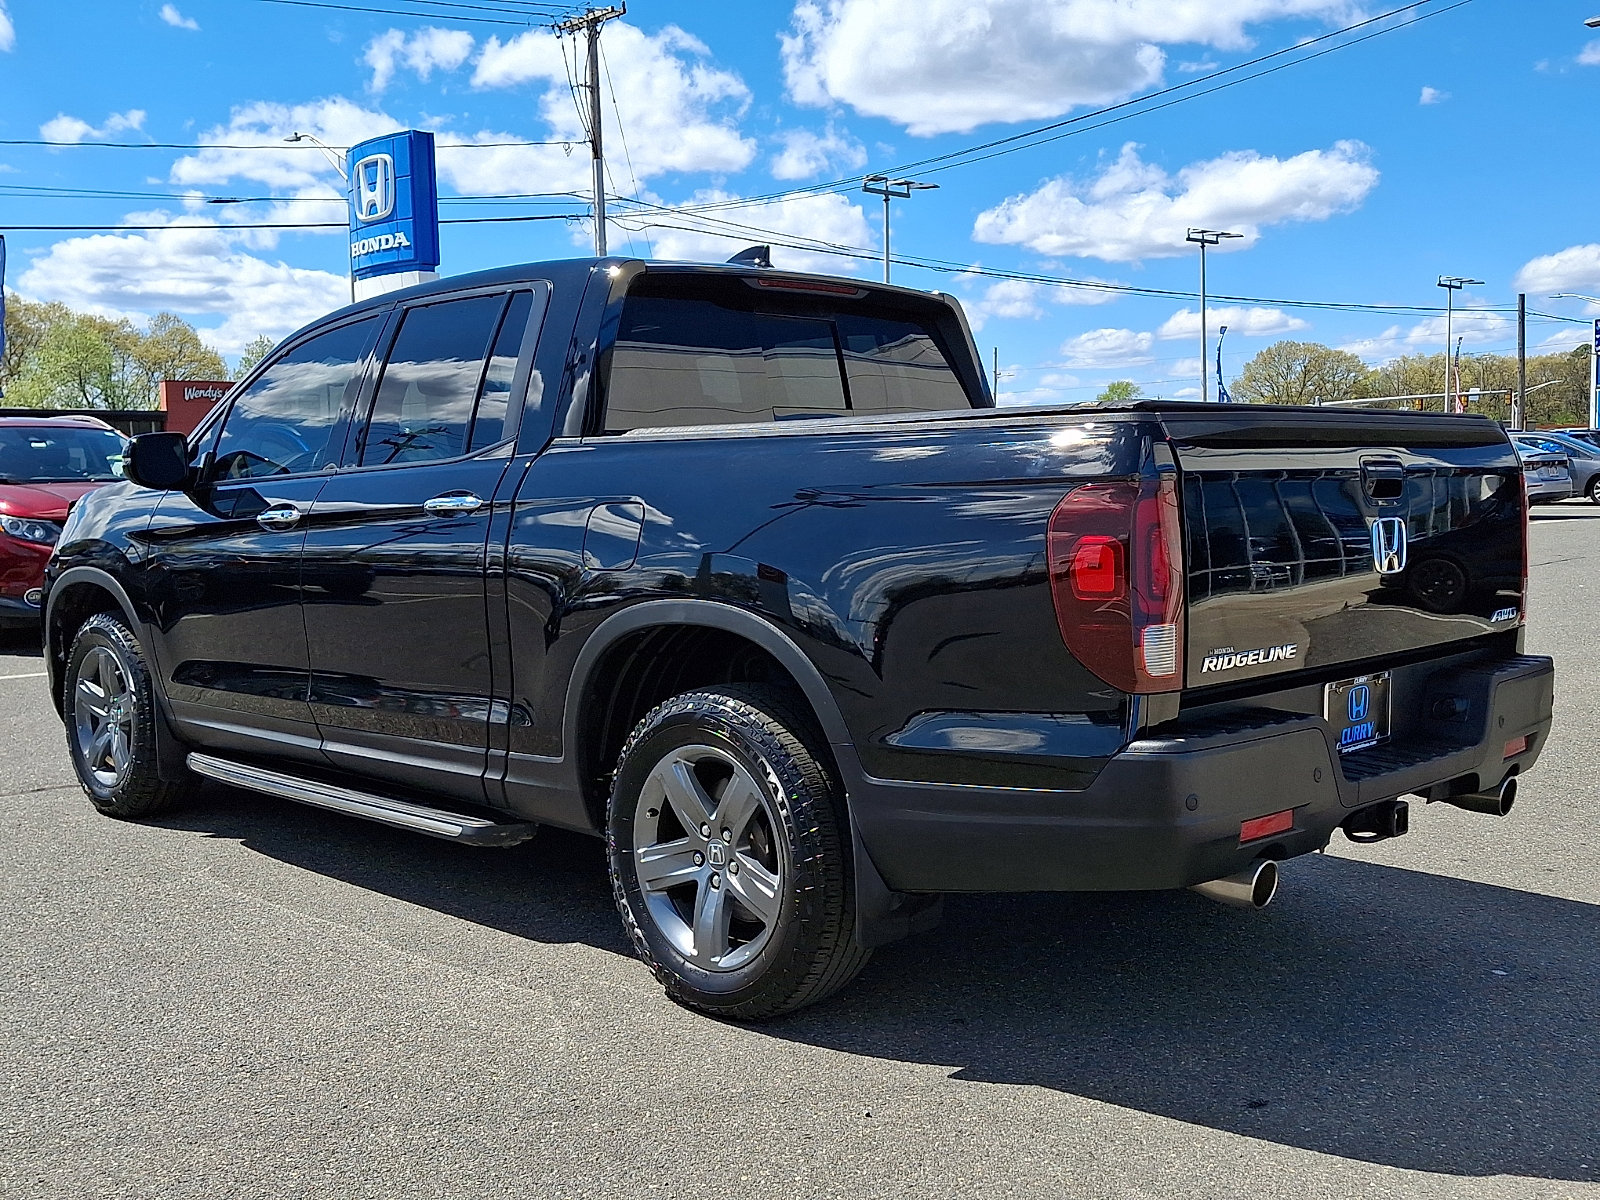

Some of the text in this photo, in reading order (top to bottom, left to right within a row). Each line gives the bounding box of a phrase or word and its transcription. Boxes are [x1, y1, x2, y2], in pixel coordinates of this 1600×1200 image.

[351, 232, 410, 257] HONDA
[184, 385, 222, 402] Wendy's
[1200, 644, 1297, 673] RIDGELINE
[1341, 721, 1374, 745] CURRY
